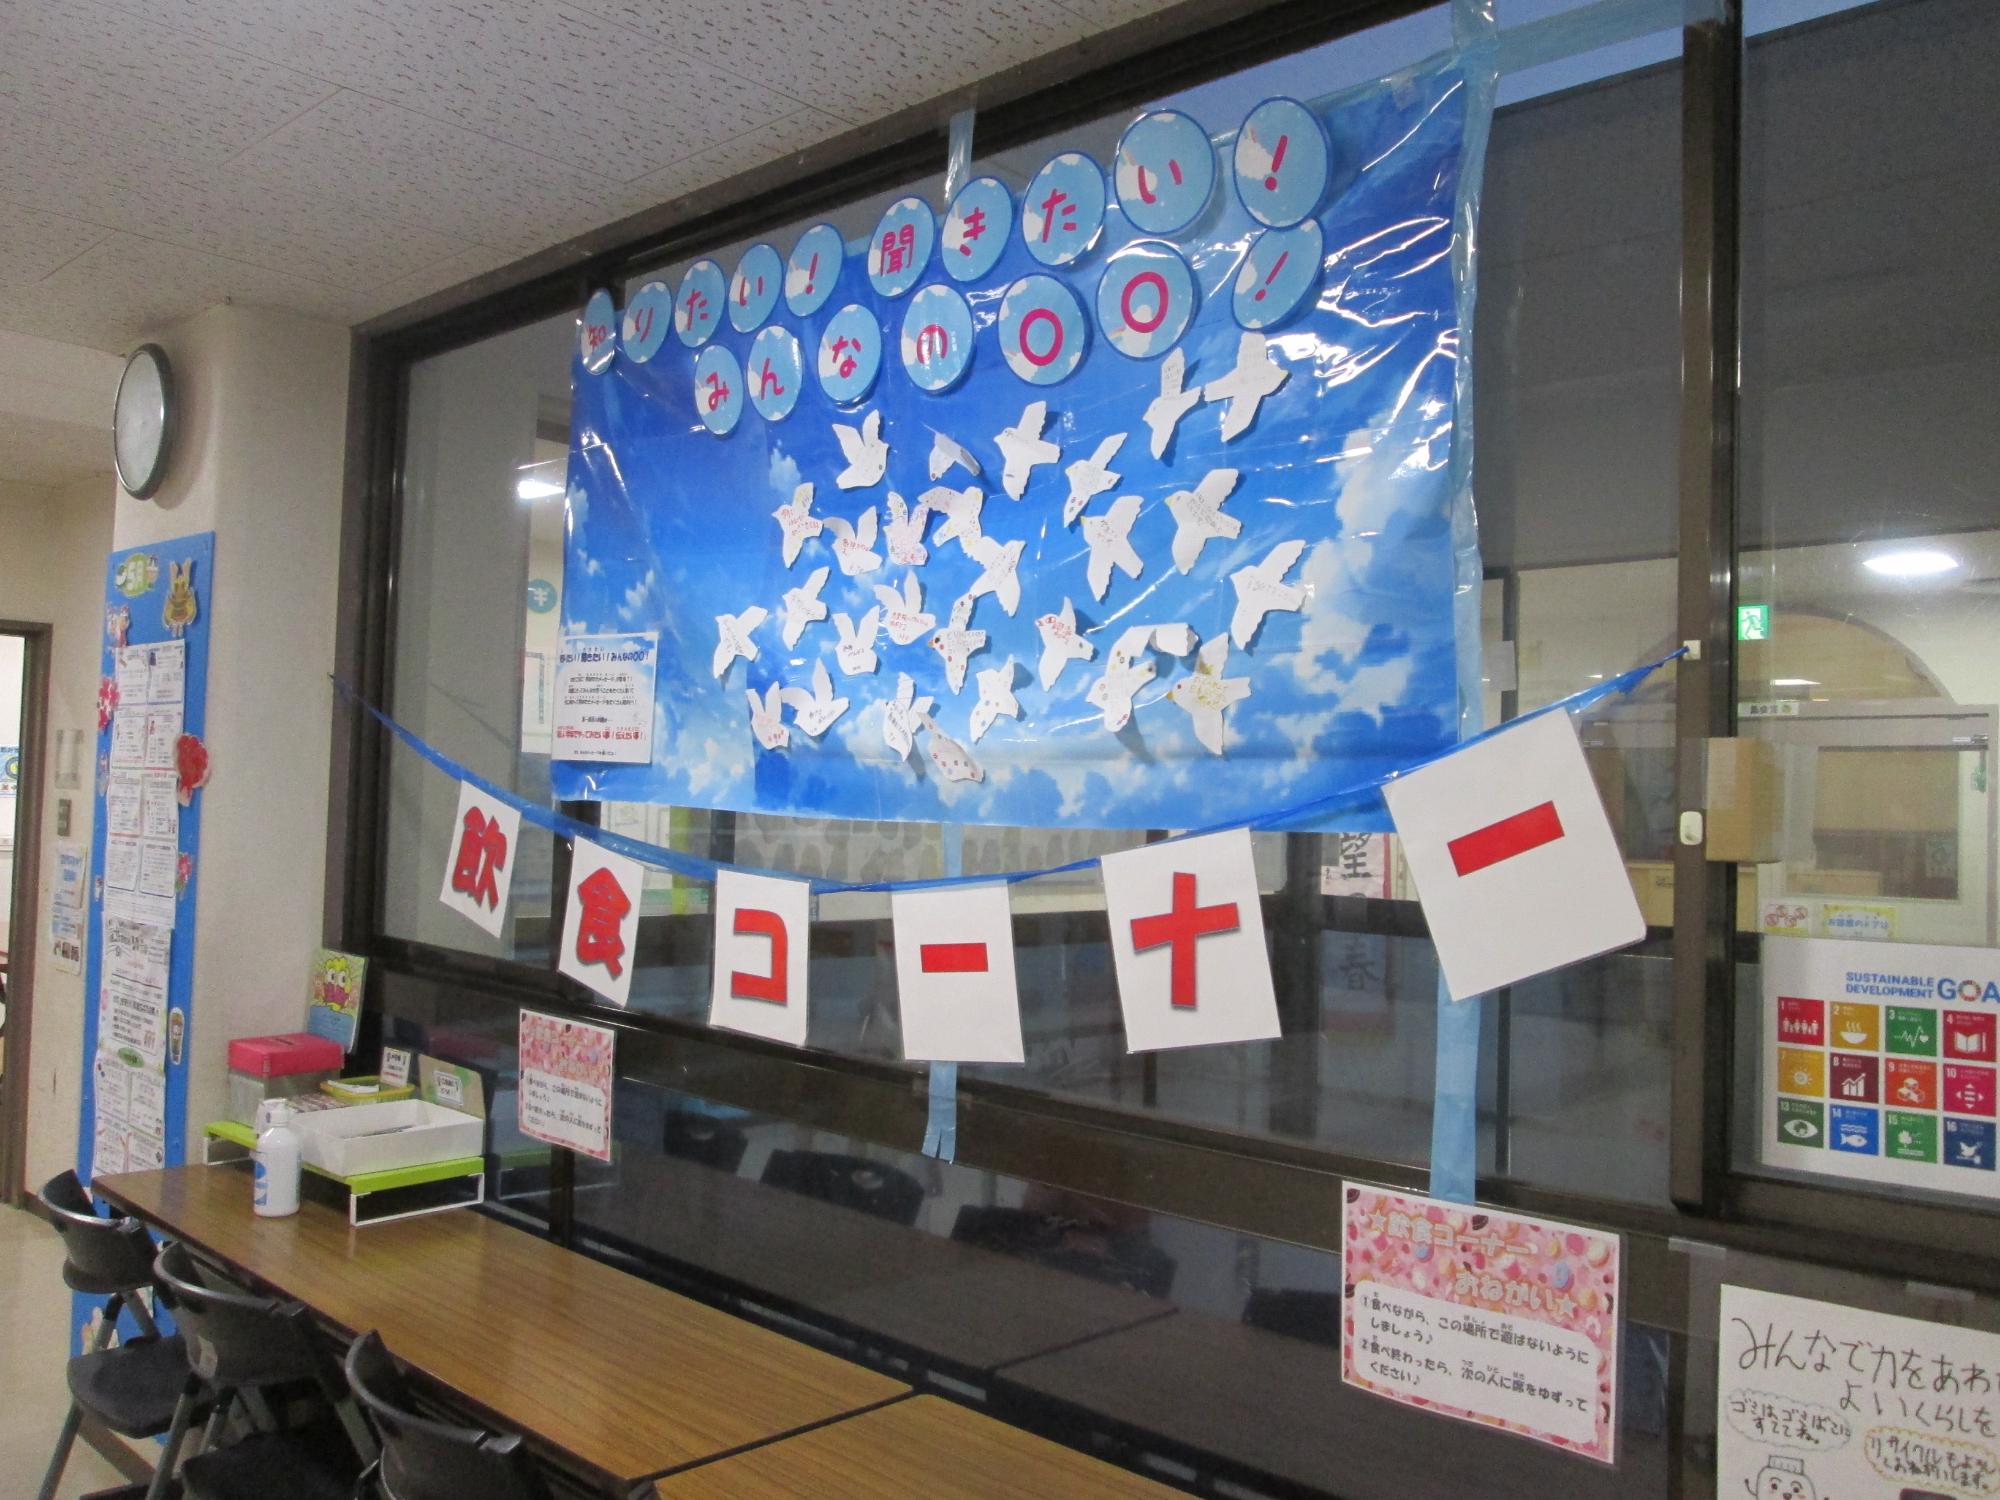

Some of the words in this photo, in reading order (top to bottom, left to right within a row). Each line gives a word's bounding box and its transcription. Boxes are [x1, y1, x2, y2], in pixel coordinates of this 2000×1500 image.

[452, 800, 1565, 1008] 飲食コーナー
[1846, 971, 1935, 987] SUSTAINABLE
[1846, 983, 1935, 999] DEVELOPMENT
[1731, 1316, 2000, 1395] みんなで力をあわ
